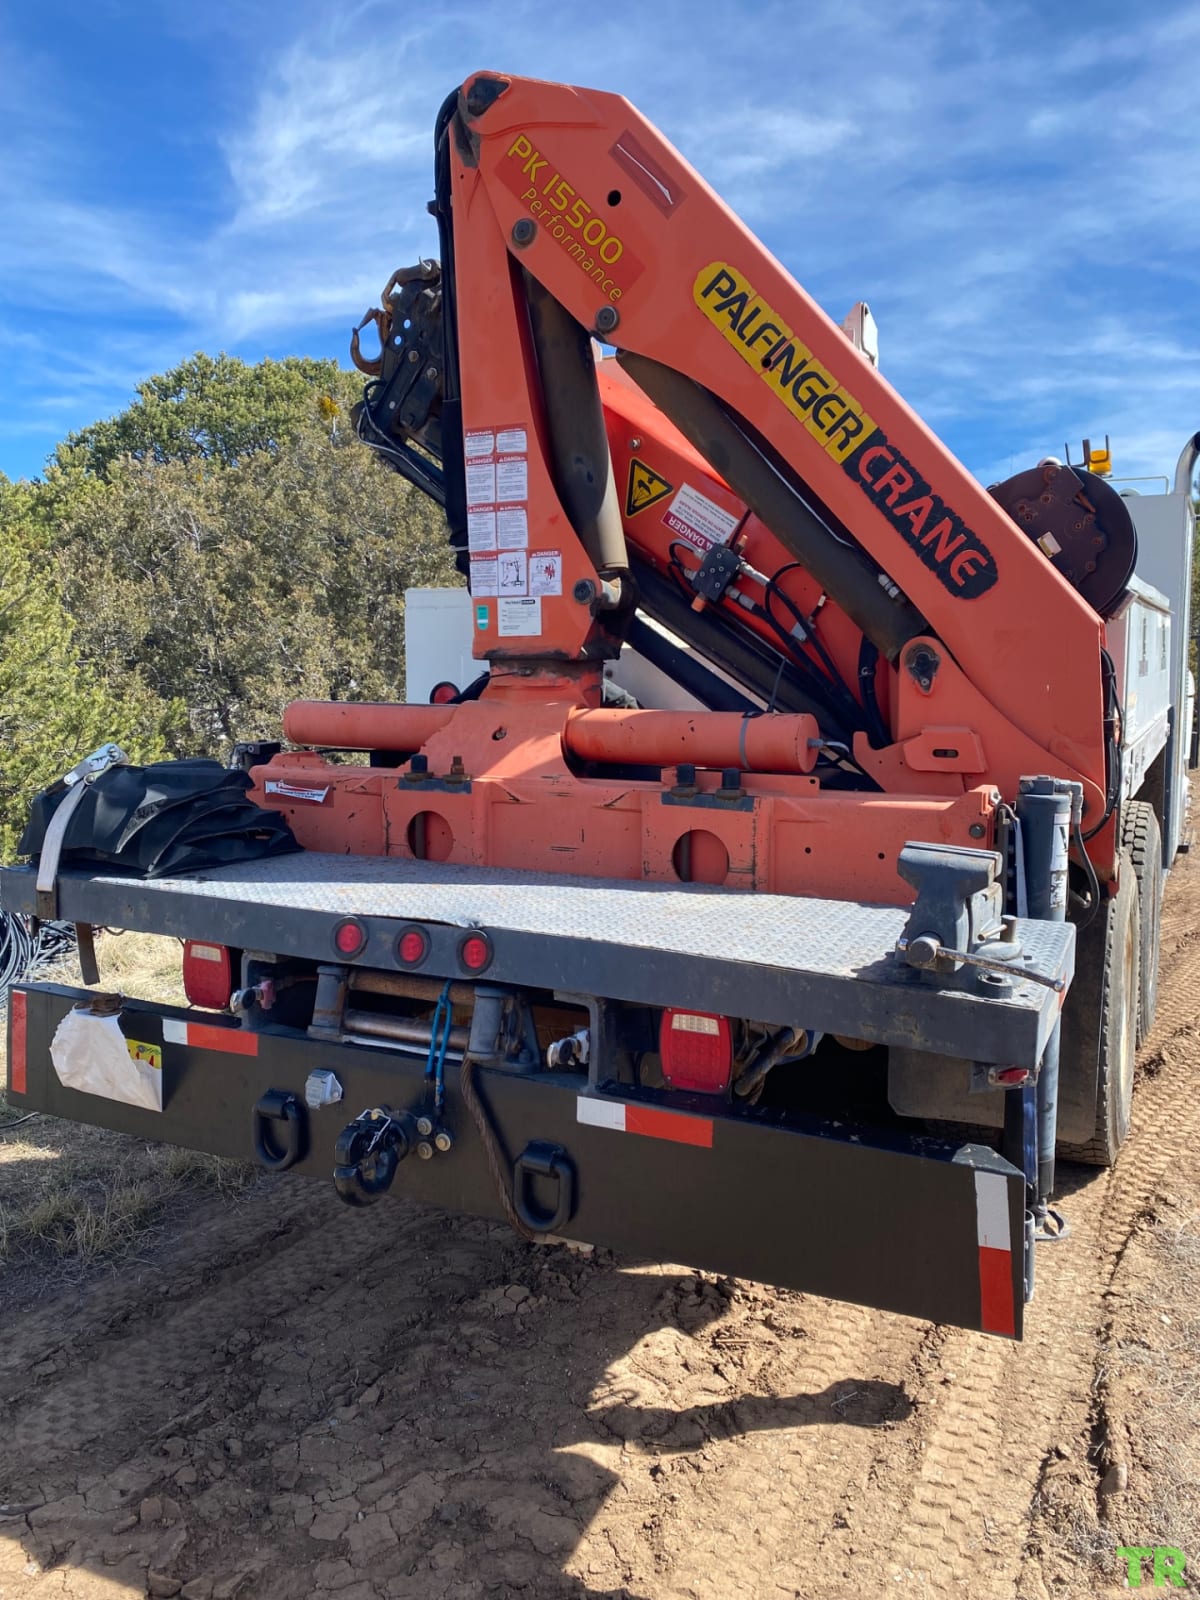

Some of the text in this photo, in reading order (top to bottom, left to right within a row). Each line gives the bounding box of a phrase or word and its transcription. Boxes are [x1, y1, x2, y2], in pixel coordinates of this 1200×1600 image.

[507, 135, 623, 264] PK 15500
[521, 188, 622, 301] Performance
[701, 269, 863, 451] PALFINGER
[668, 516, 705, 547] DANGER
[859, 447, 987, 587] CRANE
